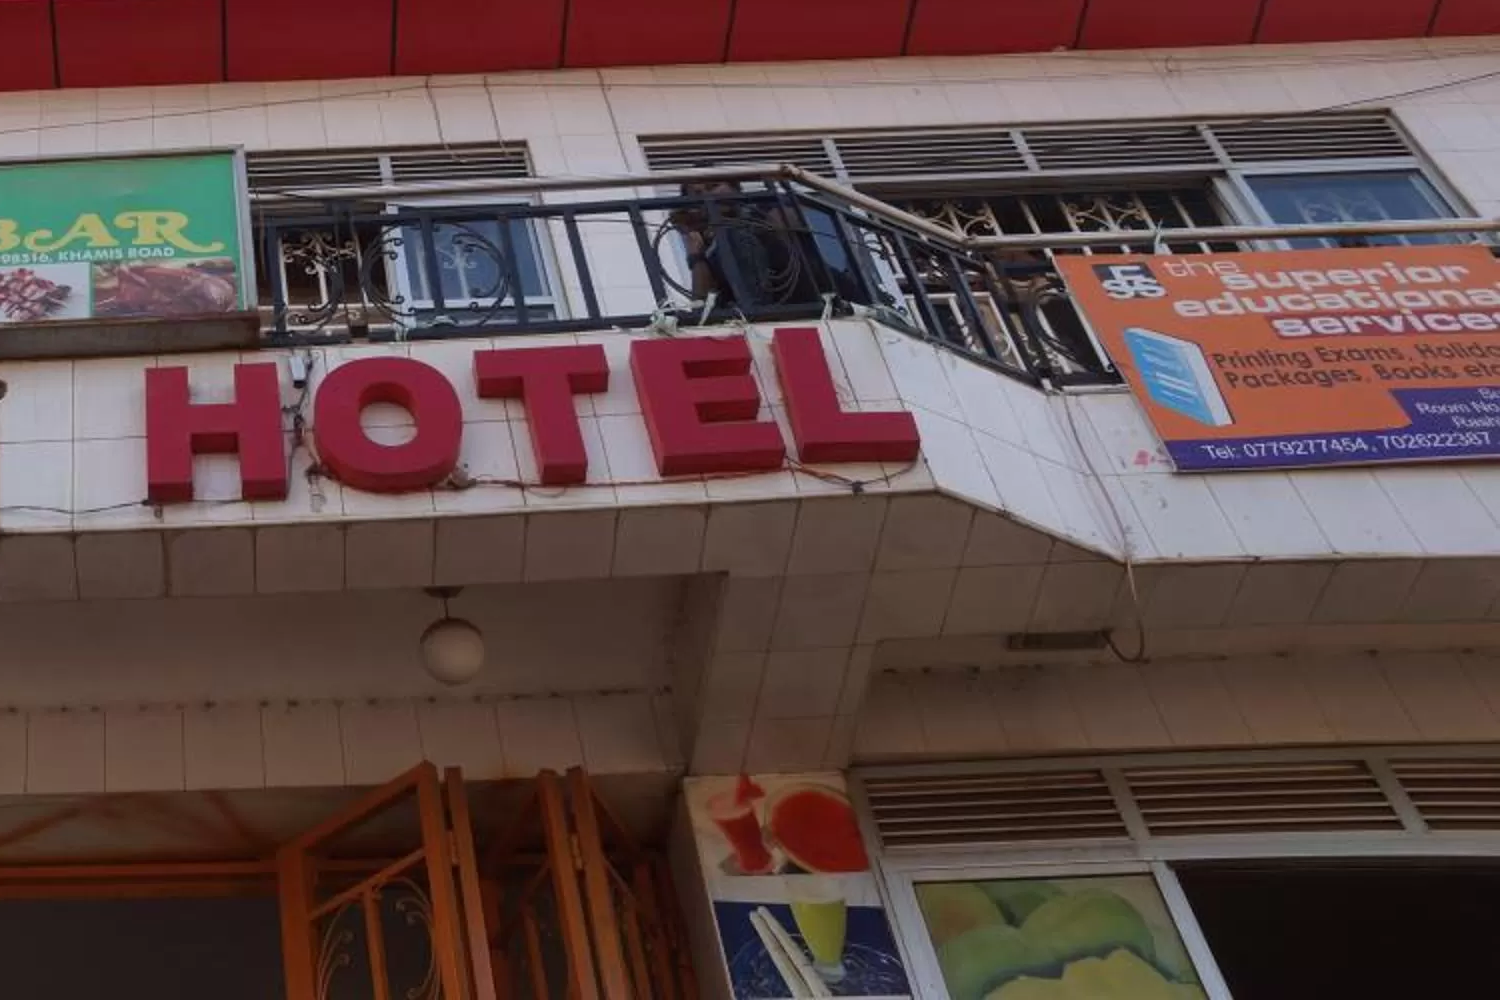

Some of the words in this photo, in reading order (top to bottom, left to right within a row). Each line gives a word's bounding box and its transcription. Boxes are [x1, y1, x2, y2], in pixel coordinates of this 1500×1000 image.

[58, 248, 124, 261] KHAMIS
[127, 246, 176, 258] ROAD
[1163, 258, 1241, 278] the
[1220, 261, 1470, 291] superior
[1270, 308, 1500, 337] service
[1212, 348, 1312, 370] Printing
[1315, 345, 1414, 364] Exams,
[1373, 363, 1459, 380] Books
[145, 327, 922, 503] HOTEL
[1201, 444, 1240, 460] Tel:
